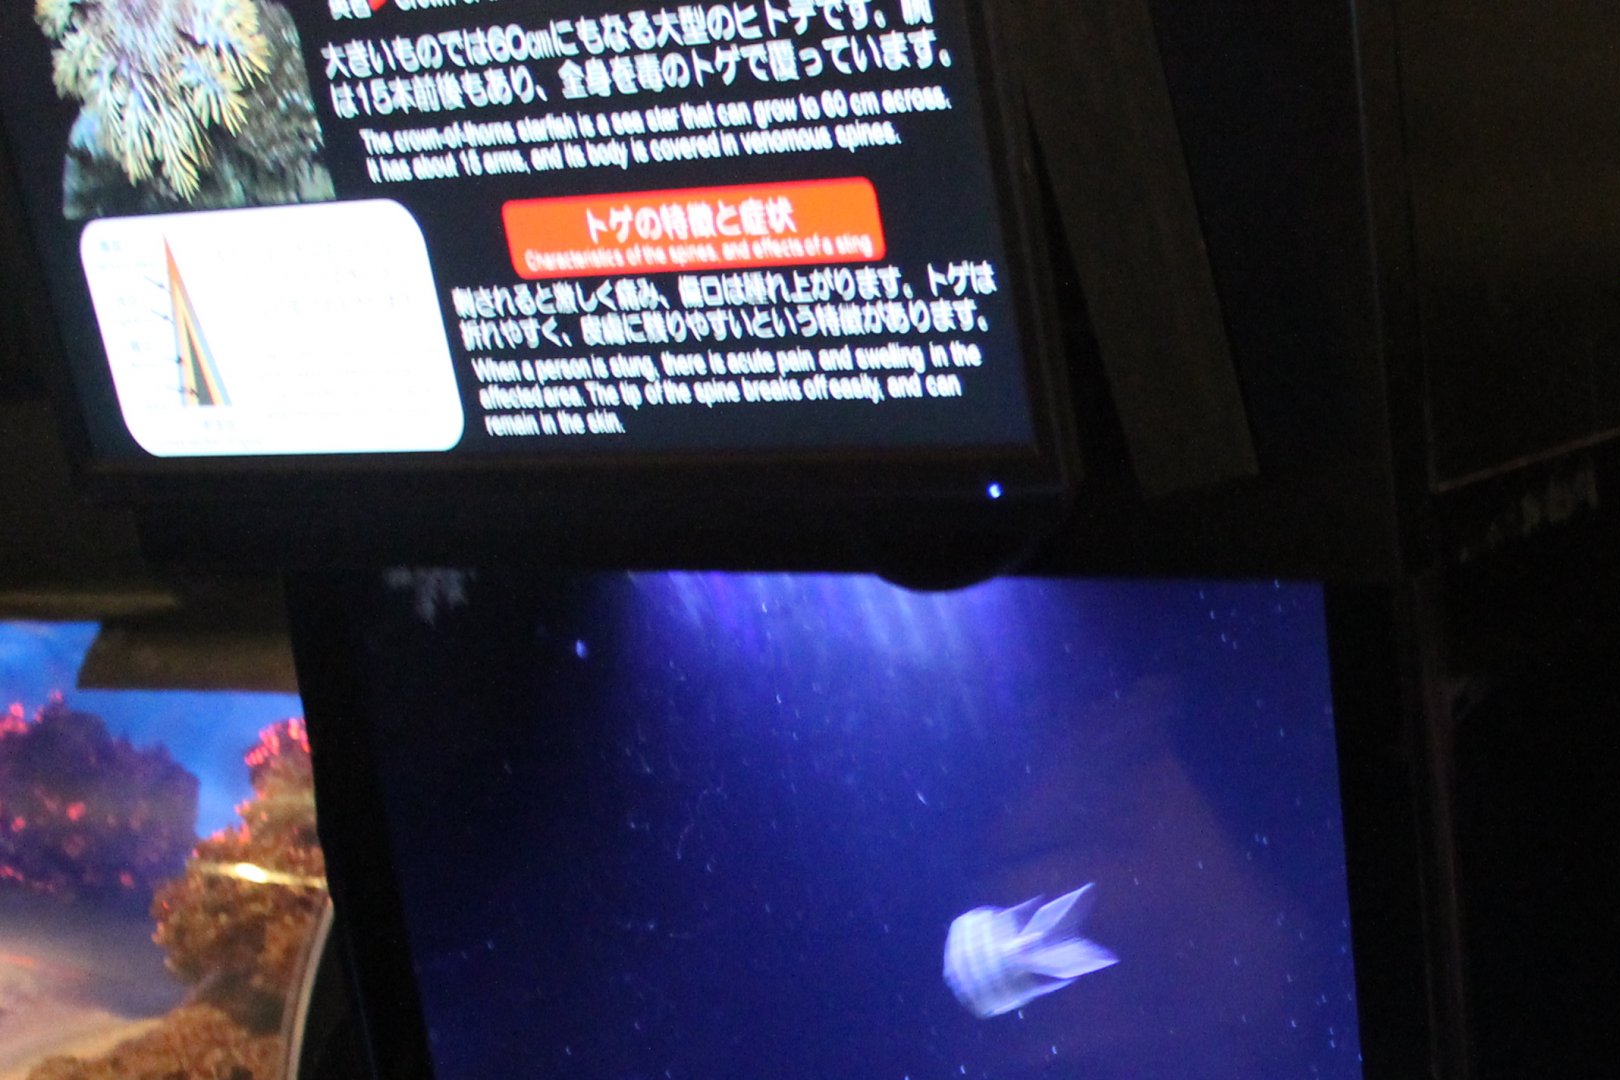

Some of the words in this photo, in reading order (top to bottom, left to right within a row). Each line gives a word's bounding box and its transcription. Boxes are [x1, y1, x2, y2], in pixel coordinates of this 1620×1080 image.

[359, 128, 394, 156] The
[393, 121, 516, 153] crown-of-thorns
[516, 113, 577, 144] starfish
[576, 111, 594, 139] is
[596, 113, 611, 137] a
[611, 110, 646, 135] sea
[645, 105, 680, 133] star
[680, 101, 717, 129] that
[717, 101, 752, 127] can
[753, 97, 798, 130] grow
[799, 94, 821, 120] to
[821, 89, 848, 119] 60
[850, 90, 880, 116] cm
[881, 85, 952, 113] across.
[366, 157, 382, 183] It
[380, 155, 413, 182] has
[411, 150, 459, 181] about
[460, 149, 483, 177] 15
[482, 149, 531, 176] arms,
[530, 142, 565, 171] and
[564, 141, 587, 169] its
[585, 138, 628, 170] body
[631, 136, 650, 164] is
[649, 130, 721, 163] covered
[719, 129, 740, 157] in
[740, 125, 834, 156] venomous
[834, 120, 902, 153] spines.
[586, 196, 797, 245] トゲの特徴と症状
[525, 247, 625, 272] Characteristics
[626, 246, 644, 267] of
[643, 244, 668, 265] the
[668, 243, 720, 267] spines,
[722, 238, 749, 260] and
[752, 236, 804, 259] effects
[804, 234, 820, 256] of
[822, 236, 833, 256] a
[835, 234, 874, 258] sting
[472, 357, 521, 383] When
[521, 359, 534, 381] a
[534, 356, 592, 385] person
[591, 354, 609, 380] is
[609, 353, 660, 382] stung,
[660, 351, 707, 377] there
[708, 350, 726, 375] is
[727, 348, 776, 374] acute
[776, 346, 815, 377] pain
[818, 344, 853, 371] and
[855, 342, 925, 373] swelling
[929, 341, 949, 368] in
[949, 340, 983, 367] the
[479, 383, 544, 410] affected
[543, 384, 587, 408] area.
[584, 381, 620, 406] The
[619, 380, 642, 410] tip
[644, 379, 663, 405] of
[662, 379, 692, 405] the
[694, 377, 741, 408] spine
[742, 376, 802, 403] breaks
[803, 374, 828, 401] off
[828, 373, 885, 404] easily,
[887, 372, 923, 398] and
[925, 373, 962, 397] can
[485, 411, 540, 436] remain
[539, 410, 557, 435] in
[556, 408, 585, 434] the
[586, 408, 626, 434] skin.
